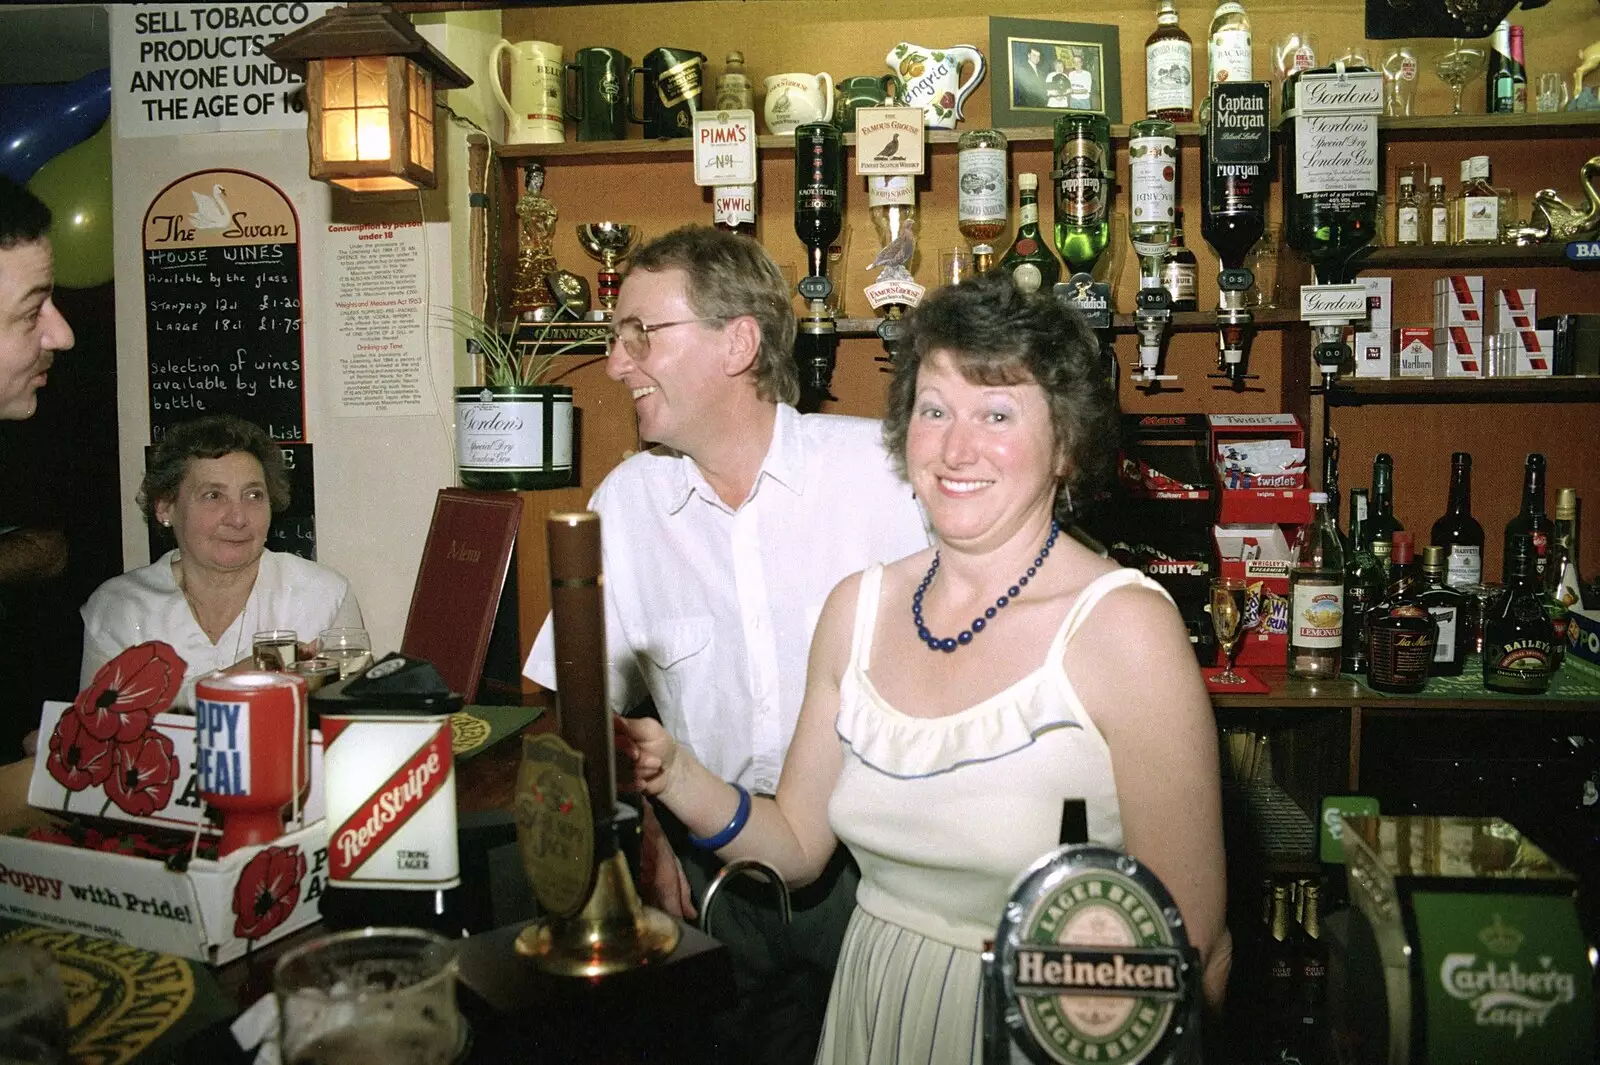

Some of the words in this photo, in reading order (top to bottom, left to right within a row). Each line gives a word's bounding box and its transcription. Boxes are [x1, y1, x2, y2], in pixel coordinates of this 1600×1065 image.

[135, 11, 187, 35] SELL
[191, 3, 309, 31] TOBACCO
[140, 34, 265, 63] PRODUCTS
[1217, 48, 1250, 59] BACARD
[130, 65, 228, 93] ANYONE
[233, 63, 306, 87] UNDE
[905, 63, 949, 104] angria
[1305, 82, 1379, 105] Gordon's
[142, 98, 188, 121] THE
[192, 95, 238, 119] AGE
[243, 92, 275, 116] OF
[1218, 94, 1264, 114] Captain
[861, 121, 890, 136] FAMOUS
[891, 120, 919, 135] GROUSE
[1217, 111, 1265, 130] Morgan
[1307, 116, 1368, 134] Gordon's
[701, 124, 747, 144] PIMM'S
[1311, 136, 1346, 149] Special
[1302, 150, 1352, 169] London
[1351, 149, 1375, 166] Gin
[717, 198, 751, 214] PIMM'S
[152, 215, 195, 242] The
[222, 212, 288, 238] Swan
[359, 232, 383, 241] under
[384, 231, 394, 240] 18
[149, 249, 208, 265] HOUSE
[223, 244, 283, 261] WINES
[148, 272, 203, 284] Available
[209, 272, 221, 288] by
[226, 273, 246, 283] the
[255, 272, 288, 288] glass
[1303, 293, 1363, 311] Gordon's
[156, 321, 199, 331] LARGE
[534, 327, 606, 339] GUINNESS
[151, 357, 220, 375] Selection
[229, 348, 248, 372] of
[254, 355, 300, 371] wines
[1402, 355, 1431, 369] Marlboro
[152, 375, 227, 391] available
[236, 373, 257, 397] by
[269, 376, 298, 390] the
[153, 397, 206, 411] bottle
[461, 408, 524, 431] Gordon's
[269, 424, 303, 440] List
[447, 538, 480, 564] Menu
[1301, 628, 1342, 637] LEMONAD
[196, 700, 241, 750] PPY
[196, 750, 248, 797] PEAL
[337, 809, 384, 869] Red
[379, 750, 440, 825] Stripe
[397, 859, 430, 870] LAGER
[69, 883, 122, 910] with
[122, 891, 193, 925] Pride!
[1017, 951, 1175, 988] Heineken
[1440, 952, 1575, 1003] Carlsberg
[1475, 1002, 1550, 1038] Lager
